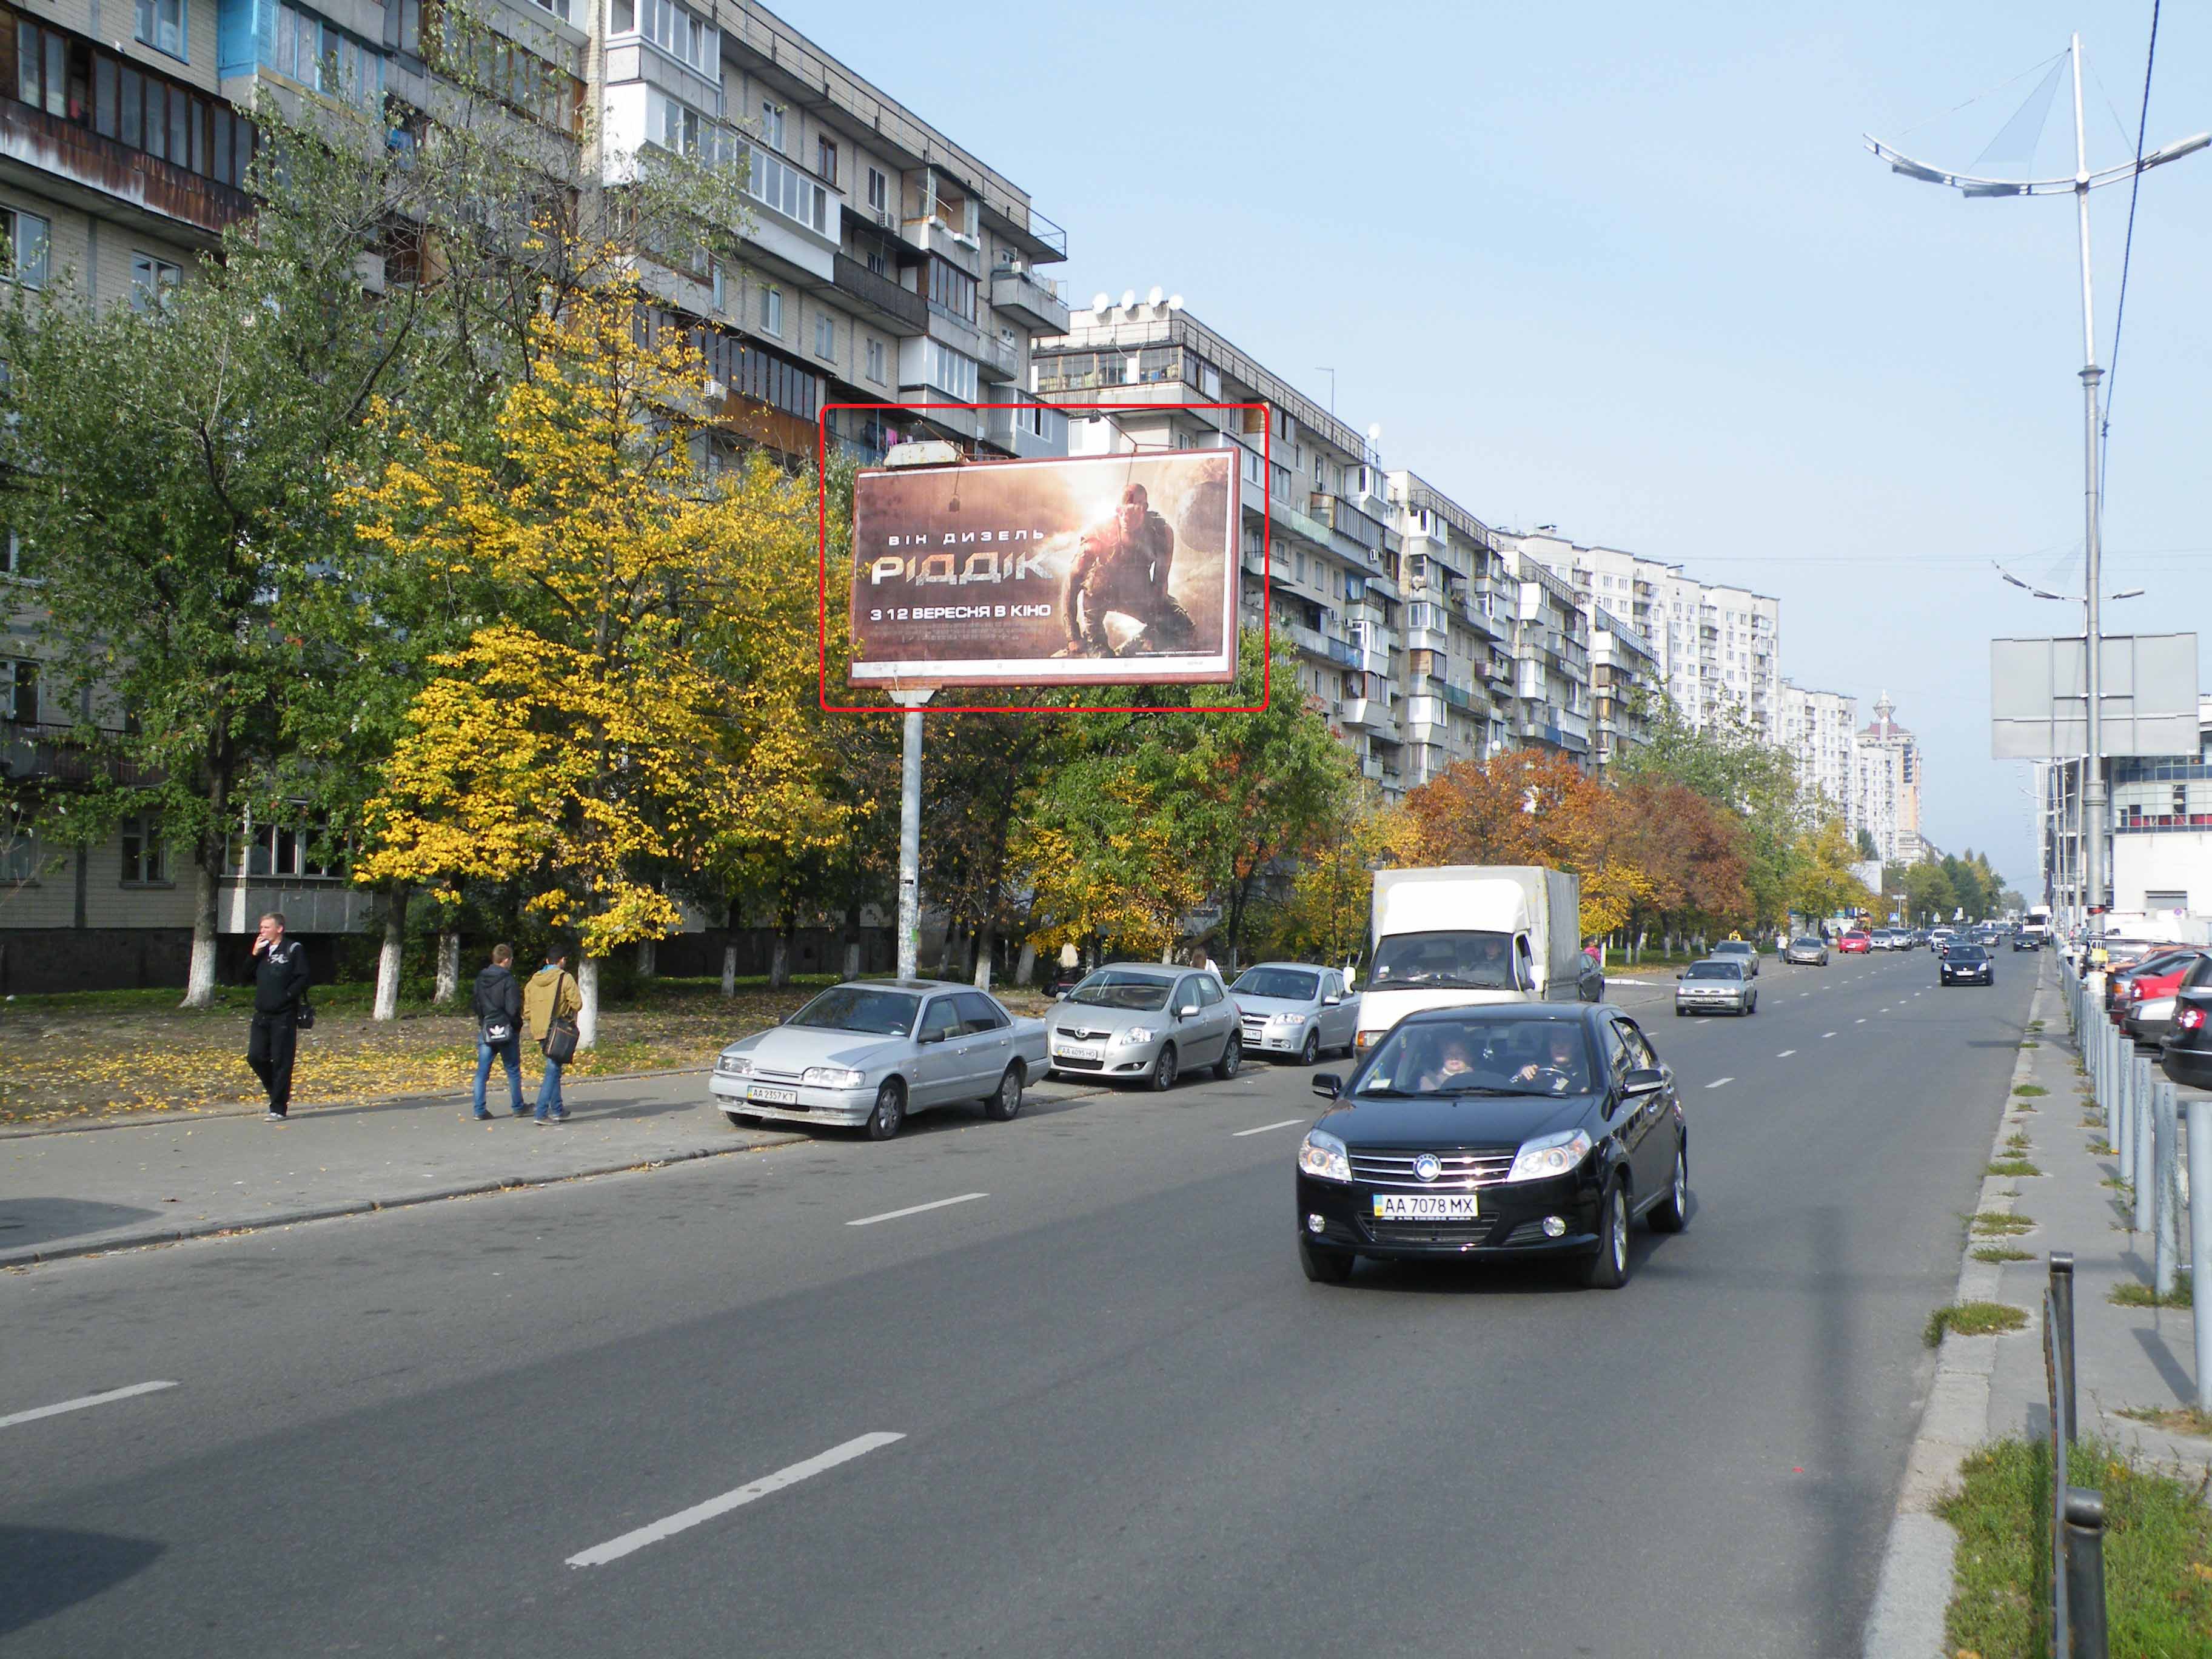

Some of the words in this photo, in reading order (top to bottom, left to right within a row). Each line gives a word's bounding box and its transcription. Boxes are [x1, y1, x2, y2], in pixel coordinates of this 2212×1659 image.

[888, 534, 928, 546] ВІН
[942, 529, 1045, 545] ДИЗЕЛЬ
[871, 551, 1054, 586] РІДДІК
[870, 608, 882, 621] З
[886, 608, 909, 620] 12
[911, 605, 991, 620] ВЕРЕСНЯ
[994, 605, 1007, 618] В
[1010, 604, 1052, 617] КІНО
[752, 1088, 763, 1098] AA
[782, 1092, 794, 1101] KT
[1384, 1198, 1406, 1213] AA
[1410, 1198, 1446, 1213] 7078
[1450, 1198, 1473, 1213] MX
